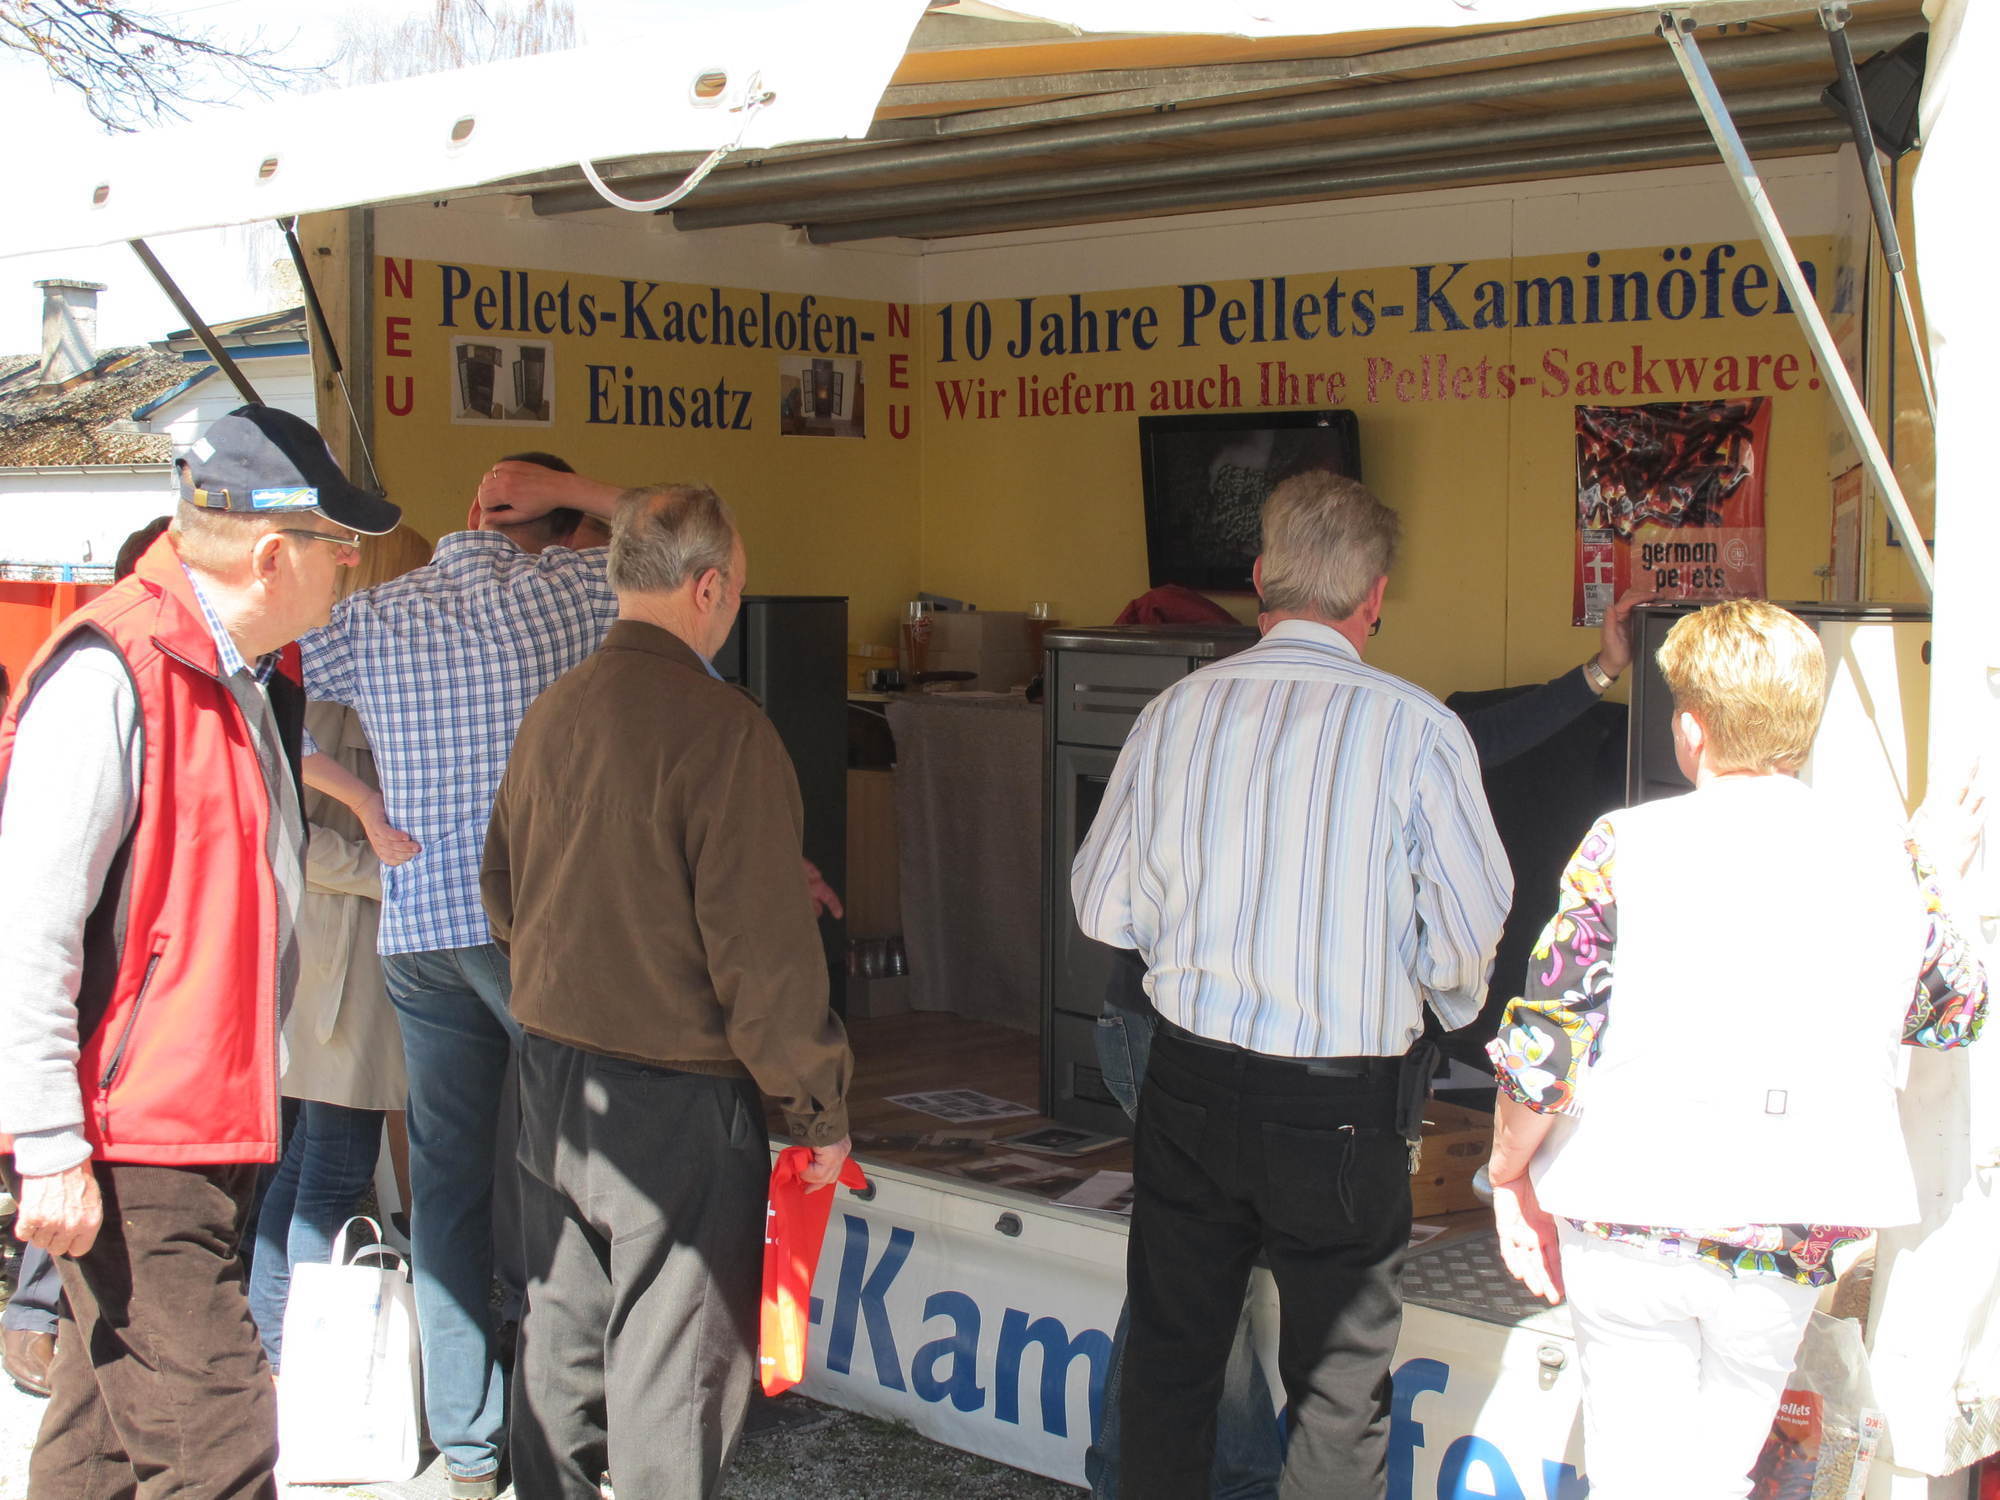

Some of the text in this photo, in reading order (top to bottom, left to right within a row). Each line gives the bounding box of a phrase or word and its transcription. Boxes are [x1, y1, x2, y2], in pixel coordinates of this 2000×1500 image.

[383, 257, 414, 416] NEU
[936, 300, 992, 363] 10
[1006, 293, 1159, 360] Jahre
[585, 363, 753, 430] Einsatz
[935, 378, 1007, 421] Wir
[1017, 371, 1136, 418] liefern
[1150, 363, 1242, 412] auch
[1256, 360, 1346, 406] Ihre
[1641, 541, 1717, 570] german
[1778, 1402, 1811, 1416] ellets
